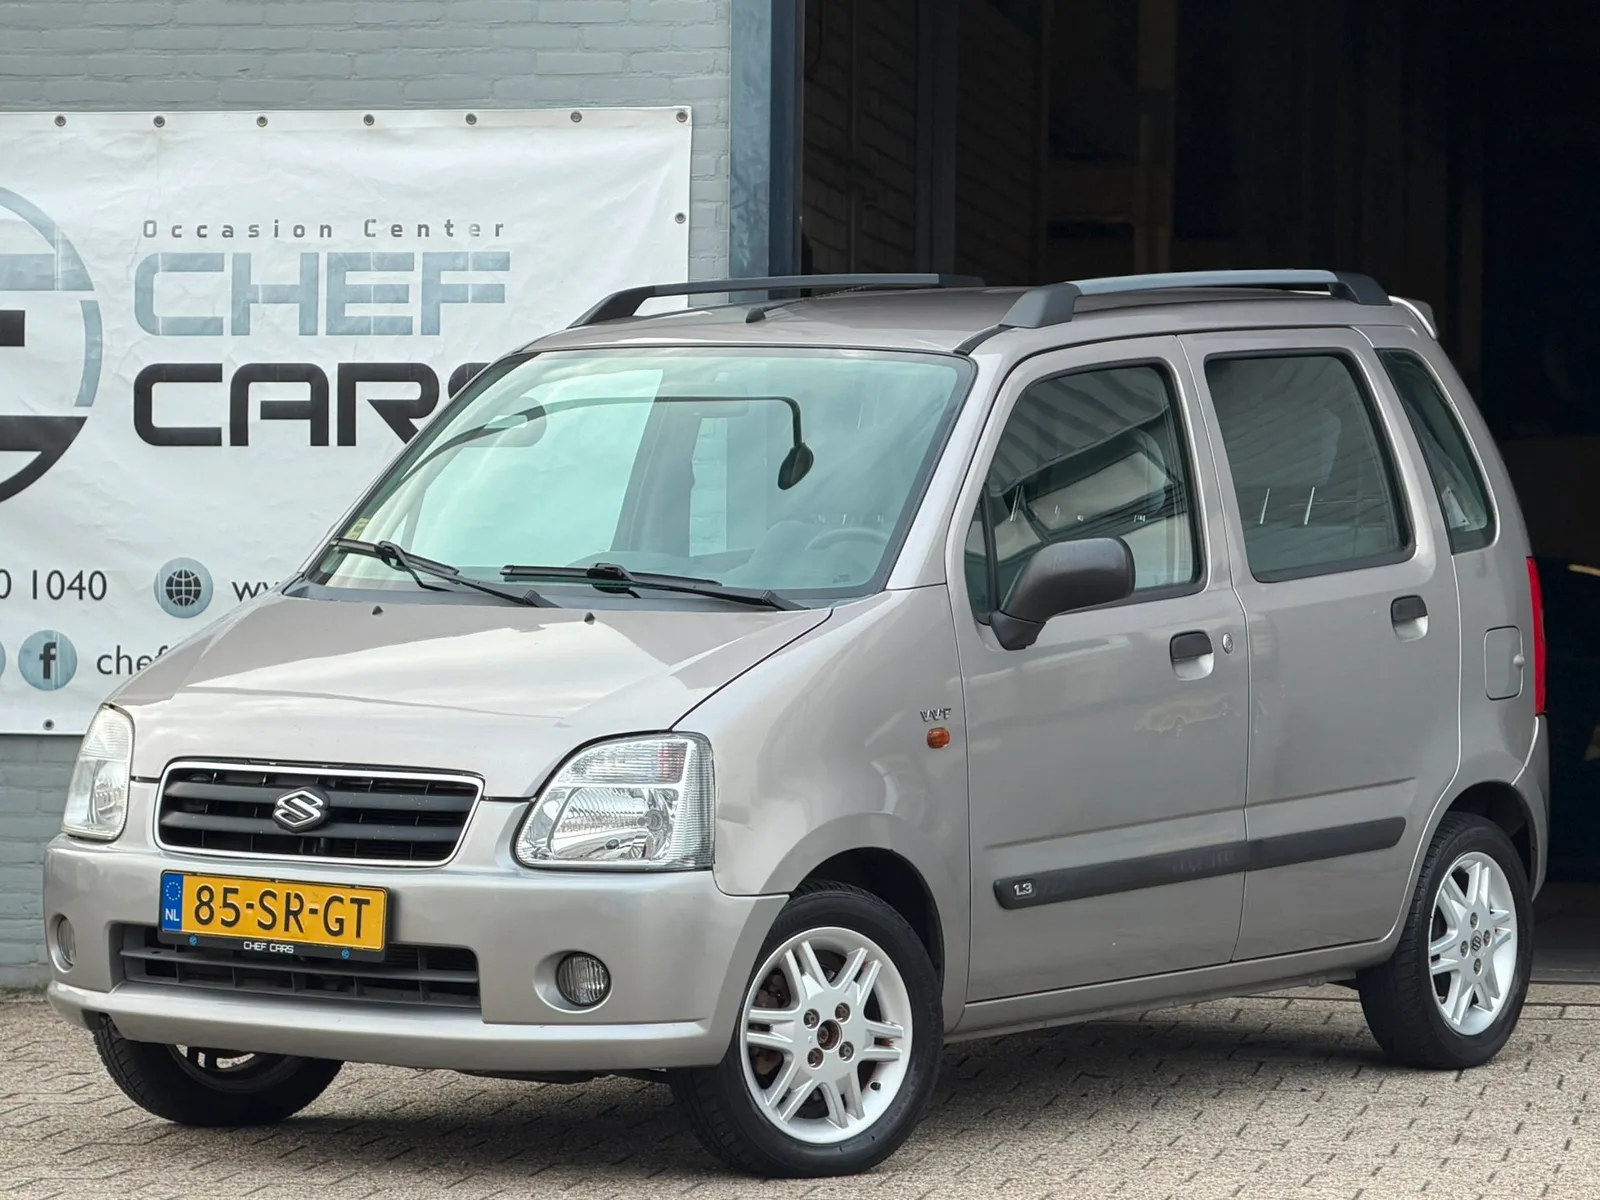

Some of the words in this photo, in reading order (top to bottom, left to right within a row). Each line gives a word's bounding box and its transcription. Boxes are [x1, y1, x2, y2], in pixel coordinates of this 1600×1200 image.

[143, 219, 333, 238] Occasion
[364, 218, 504, 238] Center
[134, 251, 510, 336] CHEF
[133, 362, 492, 447] CAR
[33, 569, 107, 601] 1040
[231, 581, 279, 602] w
[1013, 882, 1033, 896] 1.3
[165, 908, 180, 923] NL
[193, 884, 371, 939] 85-SR-GT
[243, 941, 267, 951] CHEF
[269, 943, 294, 954] CARS
